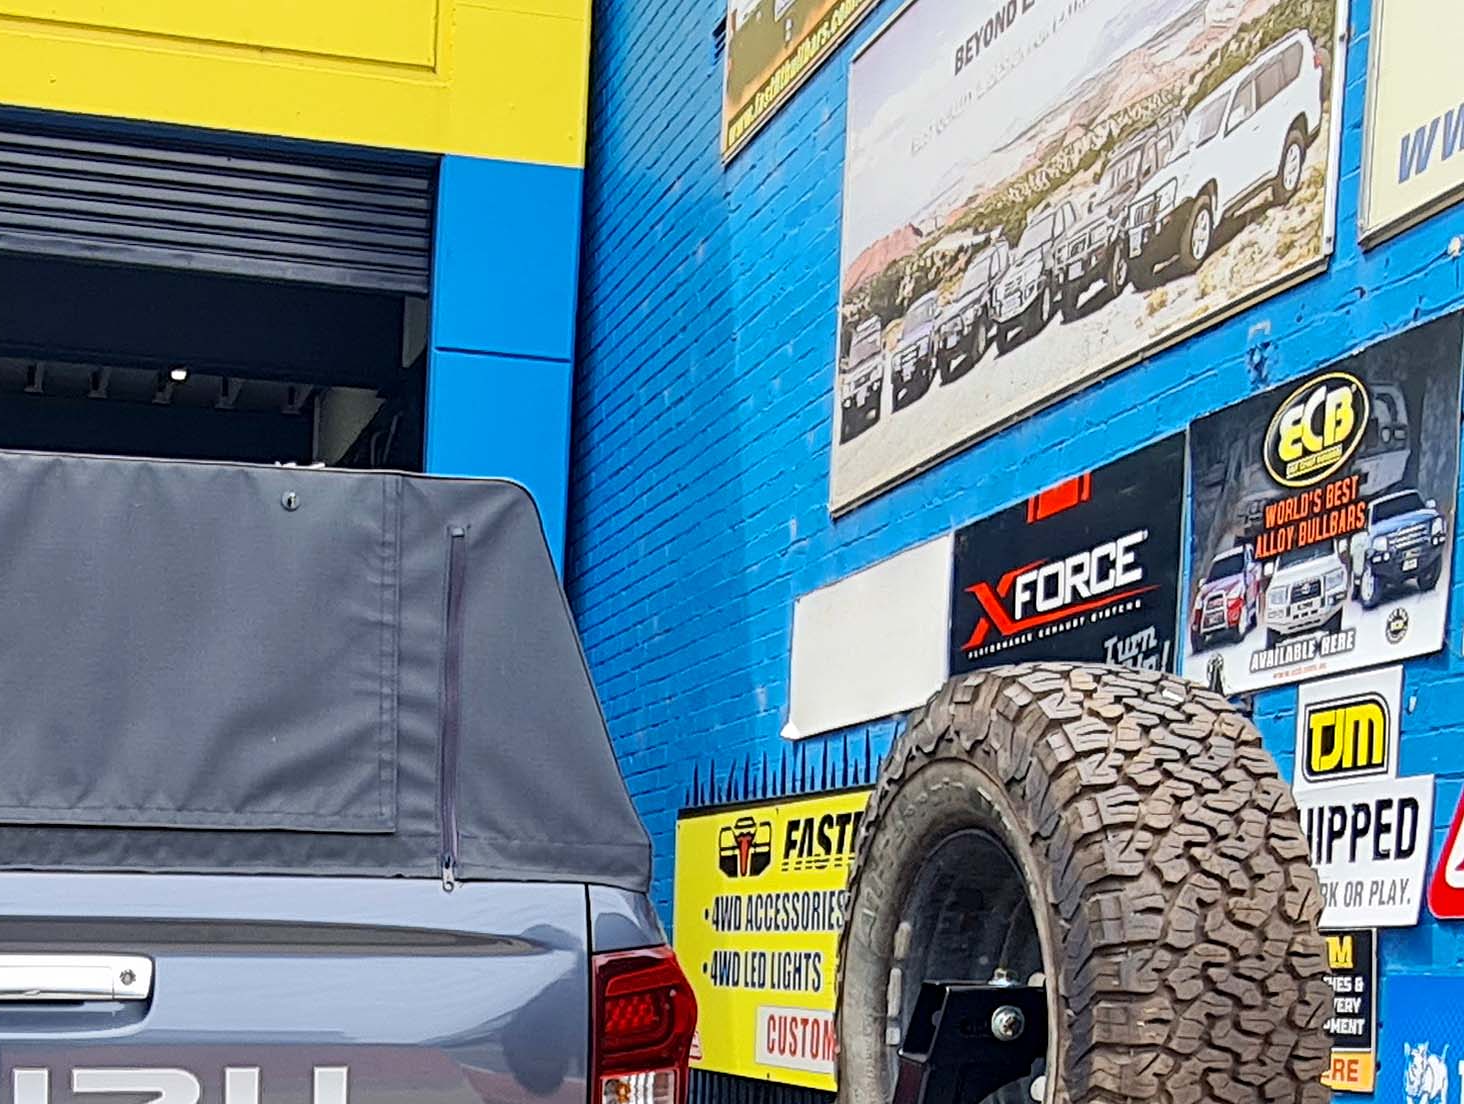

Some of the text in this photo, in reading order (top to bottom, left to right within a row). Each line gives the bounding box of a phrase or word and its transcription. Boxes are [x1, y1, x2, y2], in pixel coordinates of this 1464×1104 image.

[954, 0, 1017, 76] BEYOND
[1278, 385, 1355, 461] ECB
[1265, 475, 1359, 528] WORLD'S BEST
[1255, 502, 1367, 559] ALLOY BULLBARS
[961, 530, 1147, 652] XFORCE
[1250, 629, 1356, 672] AVAILABLE HERE
[1309, 702, 1384, 772] TJM
[713, 890, 846, 931] 4WD ACCESSORIES
[1343, 881, 1365, 907] OR
[1369, 878, 1411, 907] PLAY.
[710, 950, 822, 992] 4WD LED LIGHTS
[1323, 1018, 1366, 1035] MENT
[1321, 1058, 1360, 1082] RE
